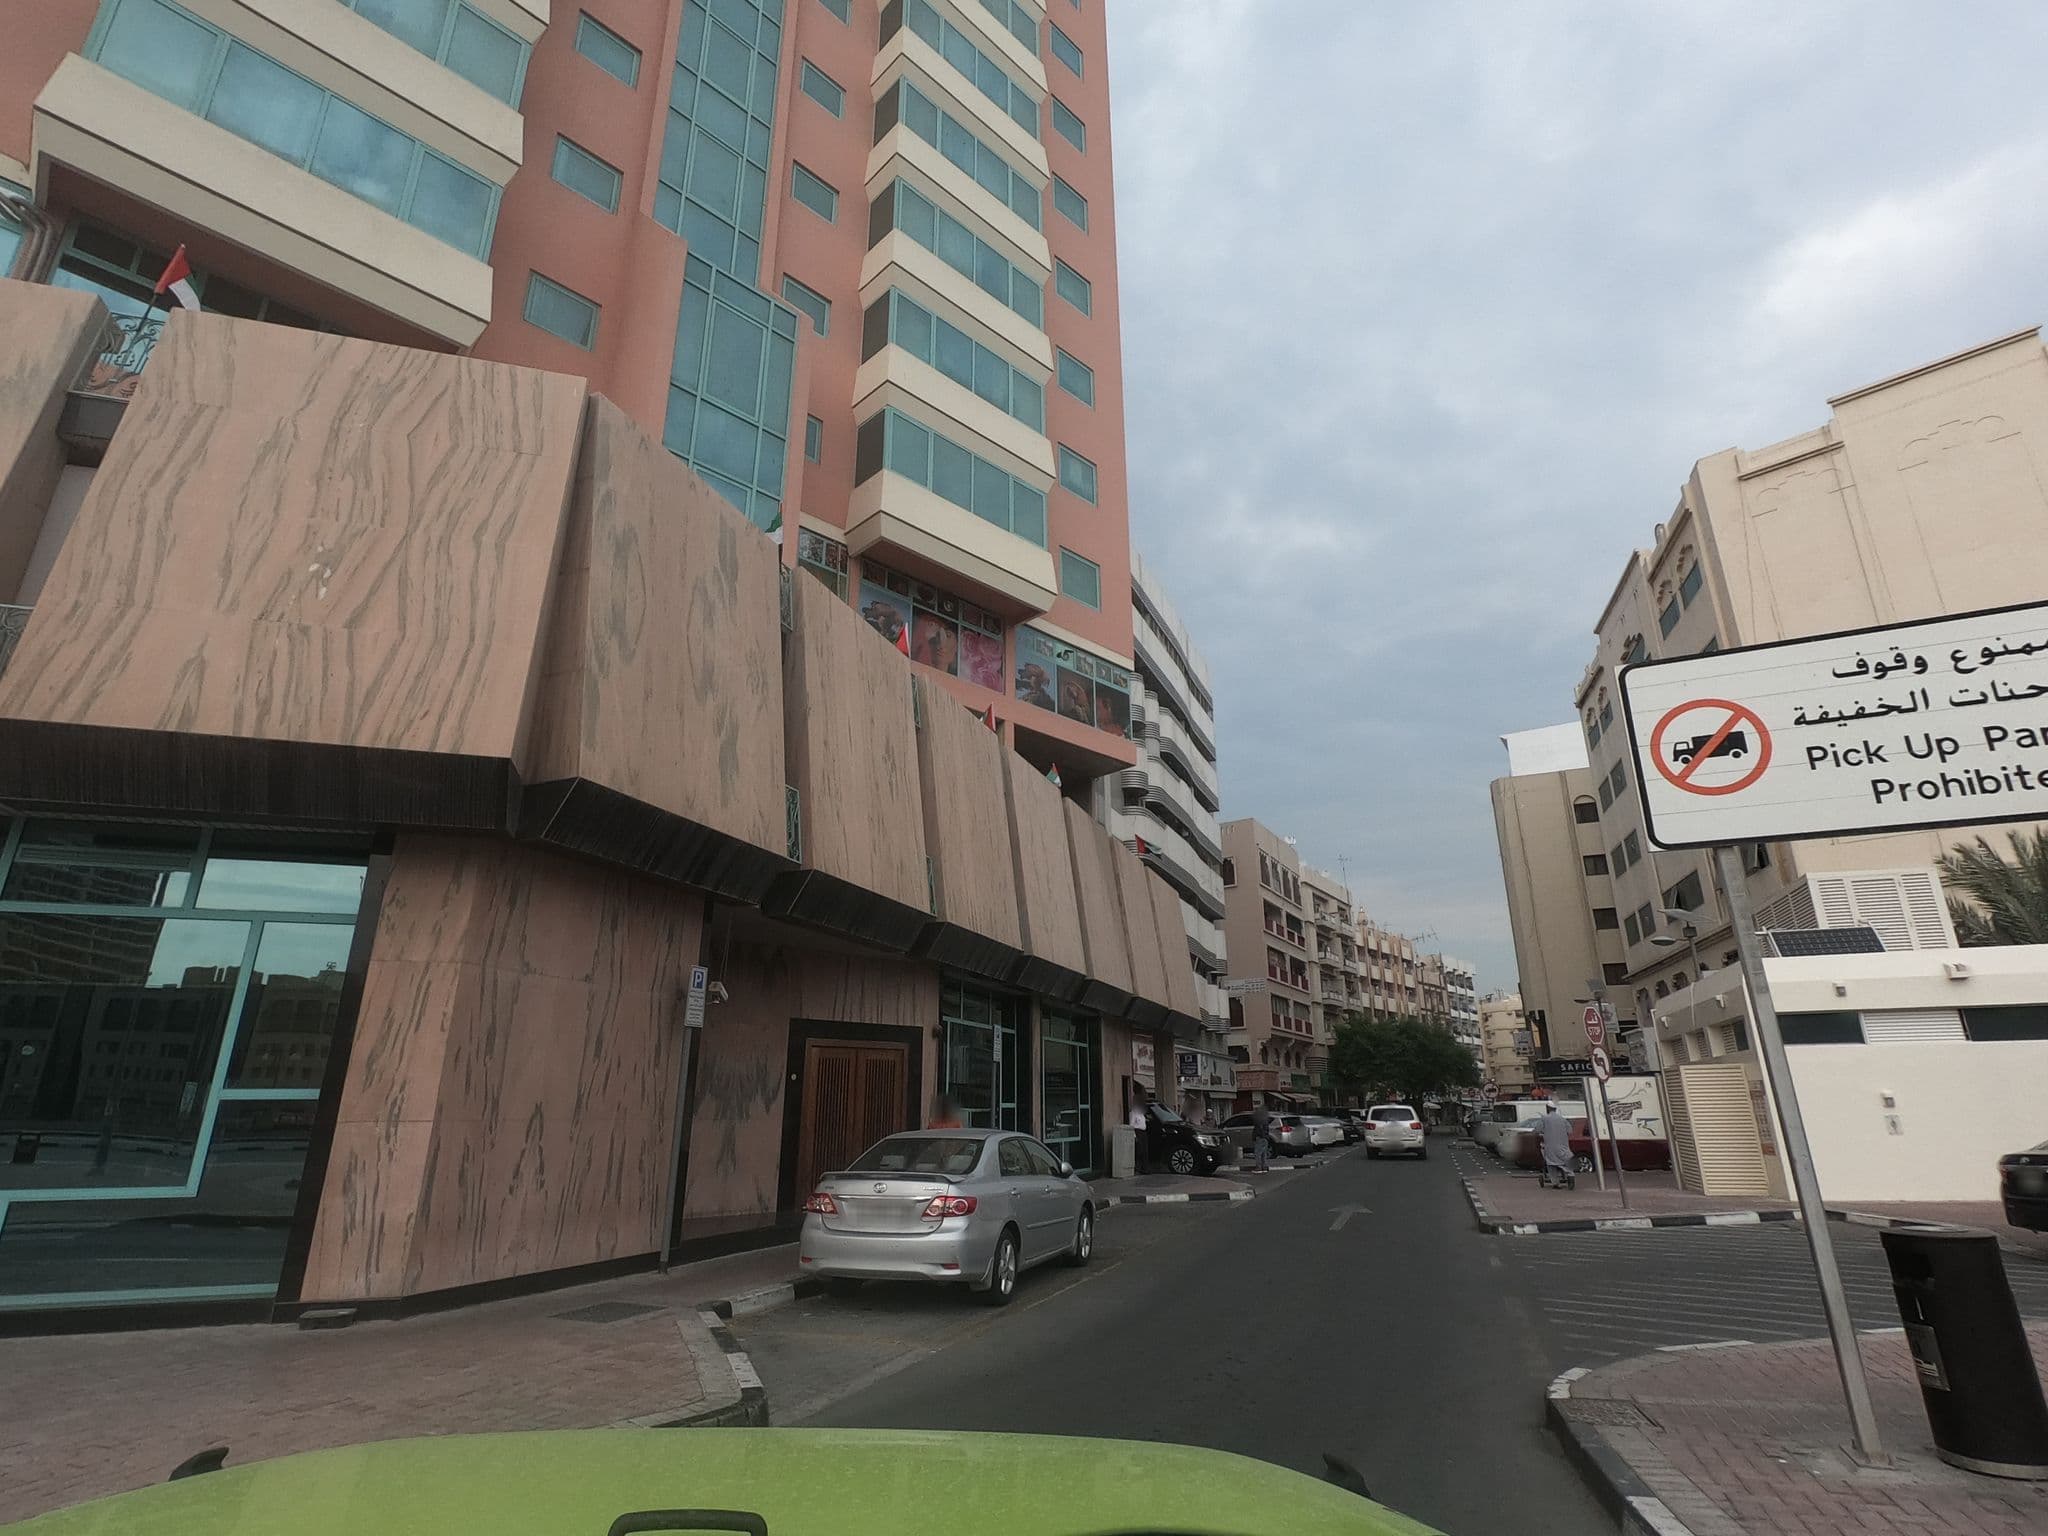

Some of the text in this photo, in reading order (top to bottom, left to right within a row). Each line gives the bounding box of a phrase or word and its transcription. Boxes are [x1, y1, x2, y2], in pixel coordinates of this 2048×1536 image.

[1832, 645, 1929, 680] وقوف
[1793, 687, 1930, 727] الخفيفة
[1806, 740, 1889, 770] Pick
[1903, 732, 1960, 763] Up
